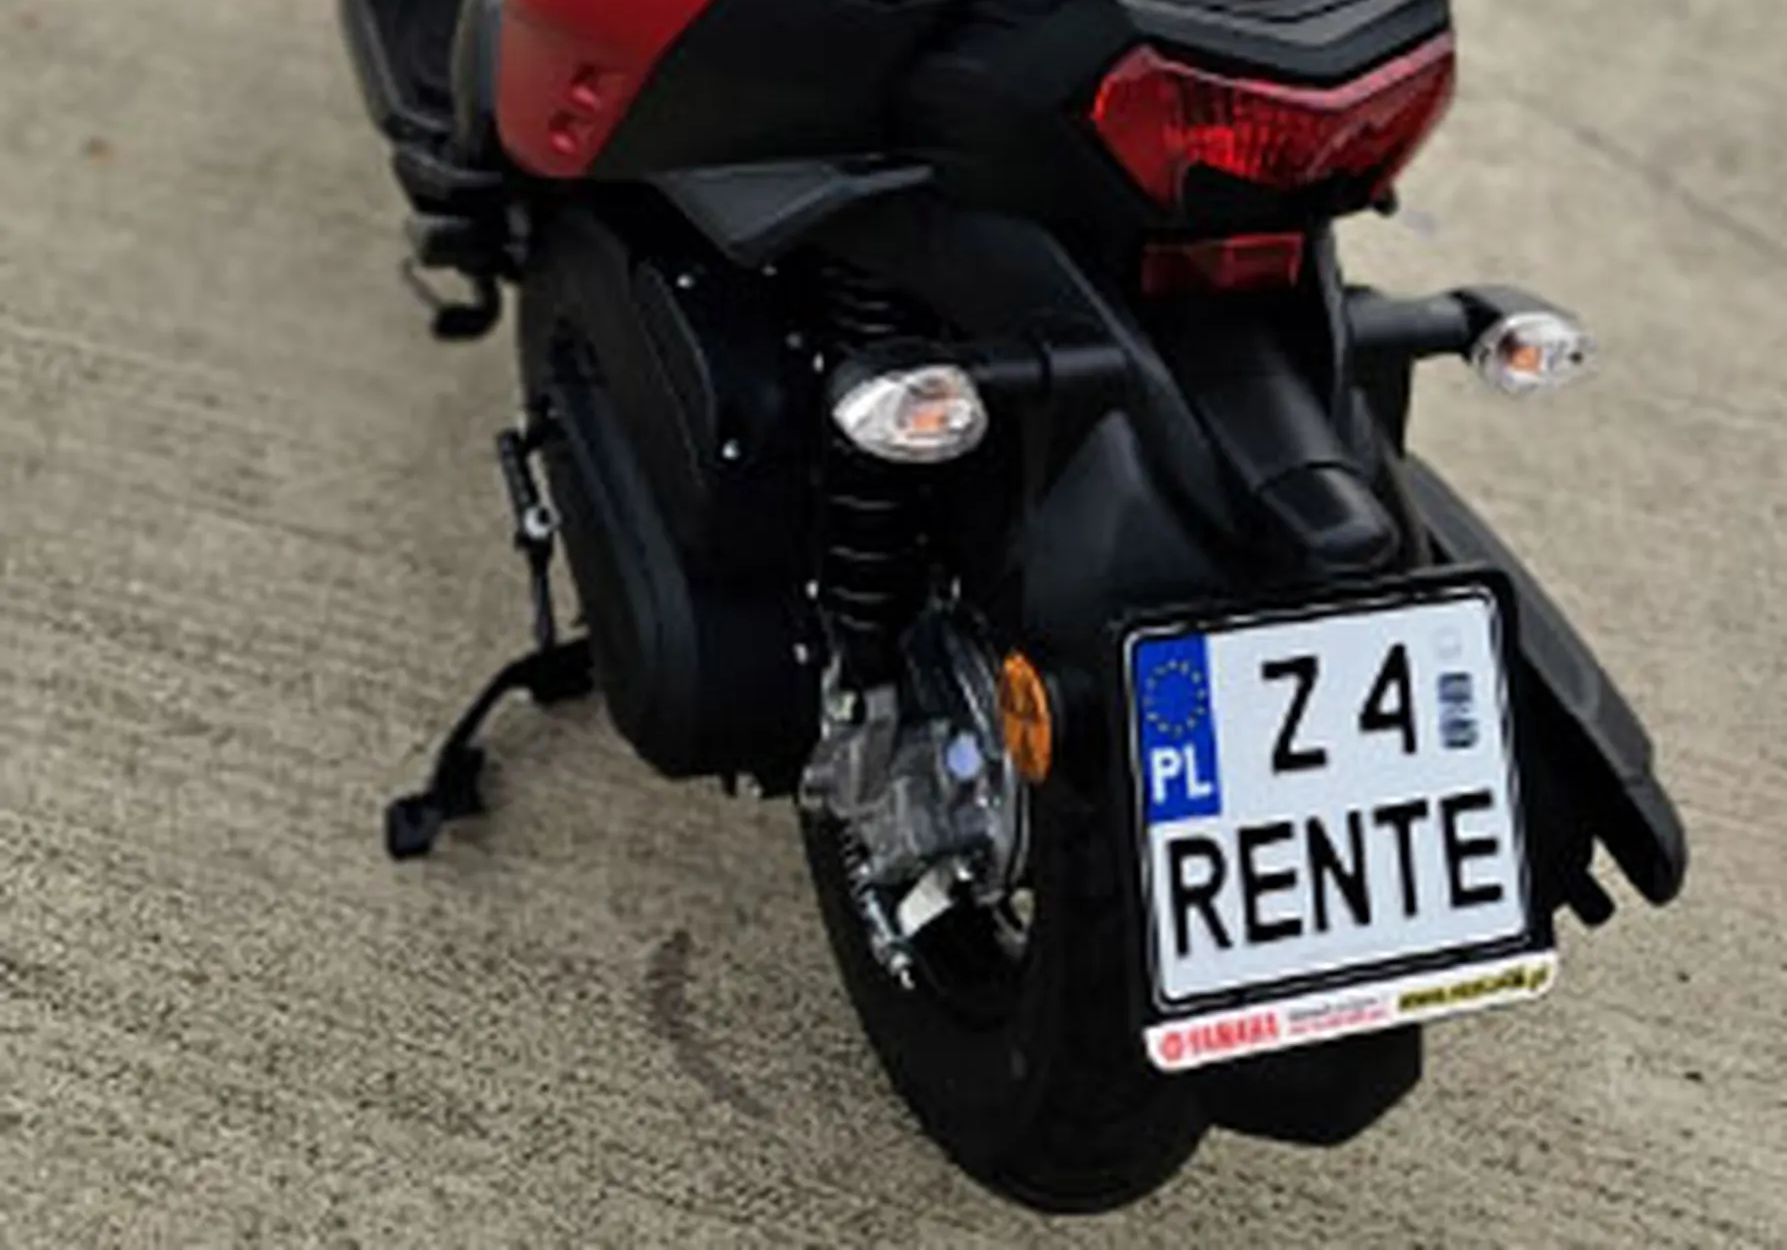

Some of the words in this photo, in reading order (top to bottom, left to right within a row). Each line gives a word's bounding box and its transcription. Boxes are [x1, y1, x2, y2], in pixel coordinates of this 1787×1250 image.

[1150, 744, 1213, 803] PL
[1260, 655, 1328, 775] Z
[1358, 642, 1417, 755] 4
[1165, 789, 1505, 960] RENTE
